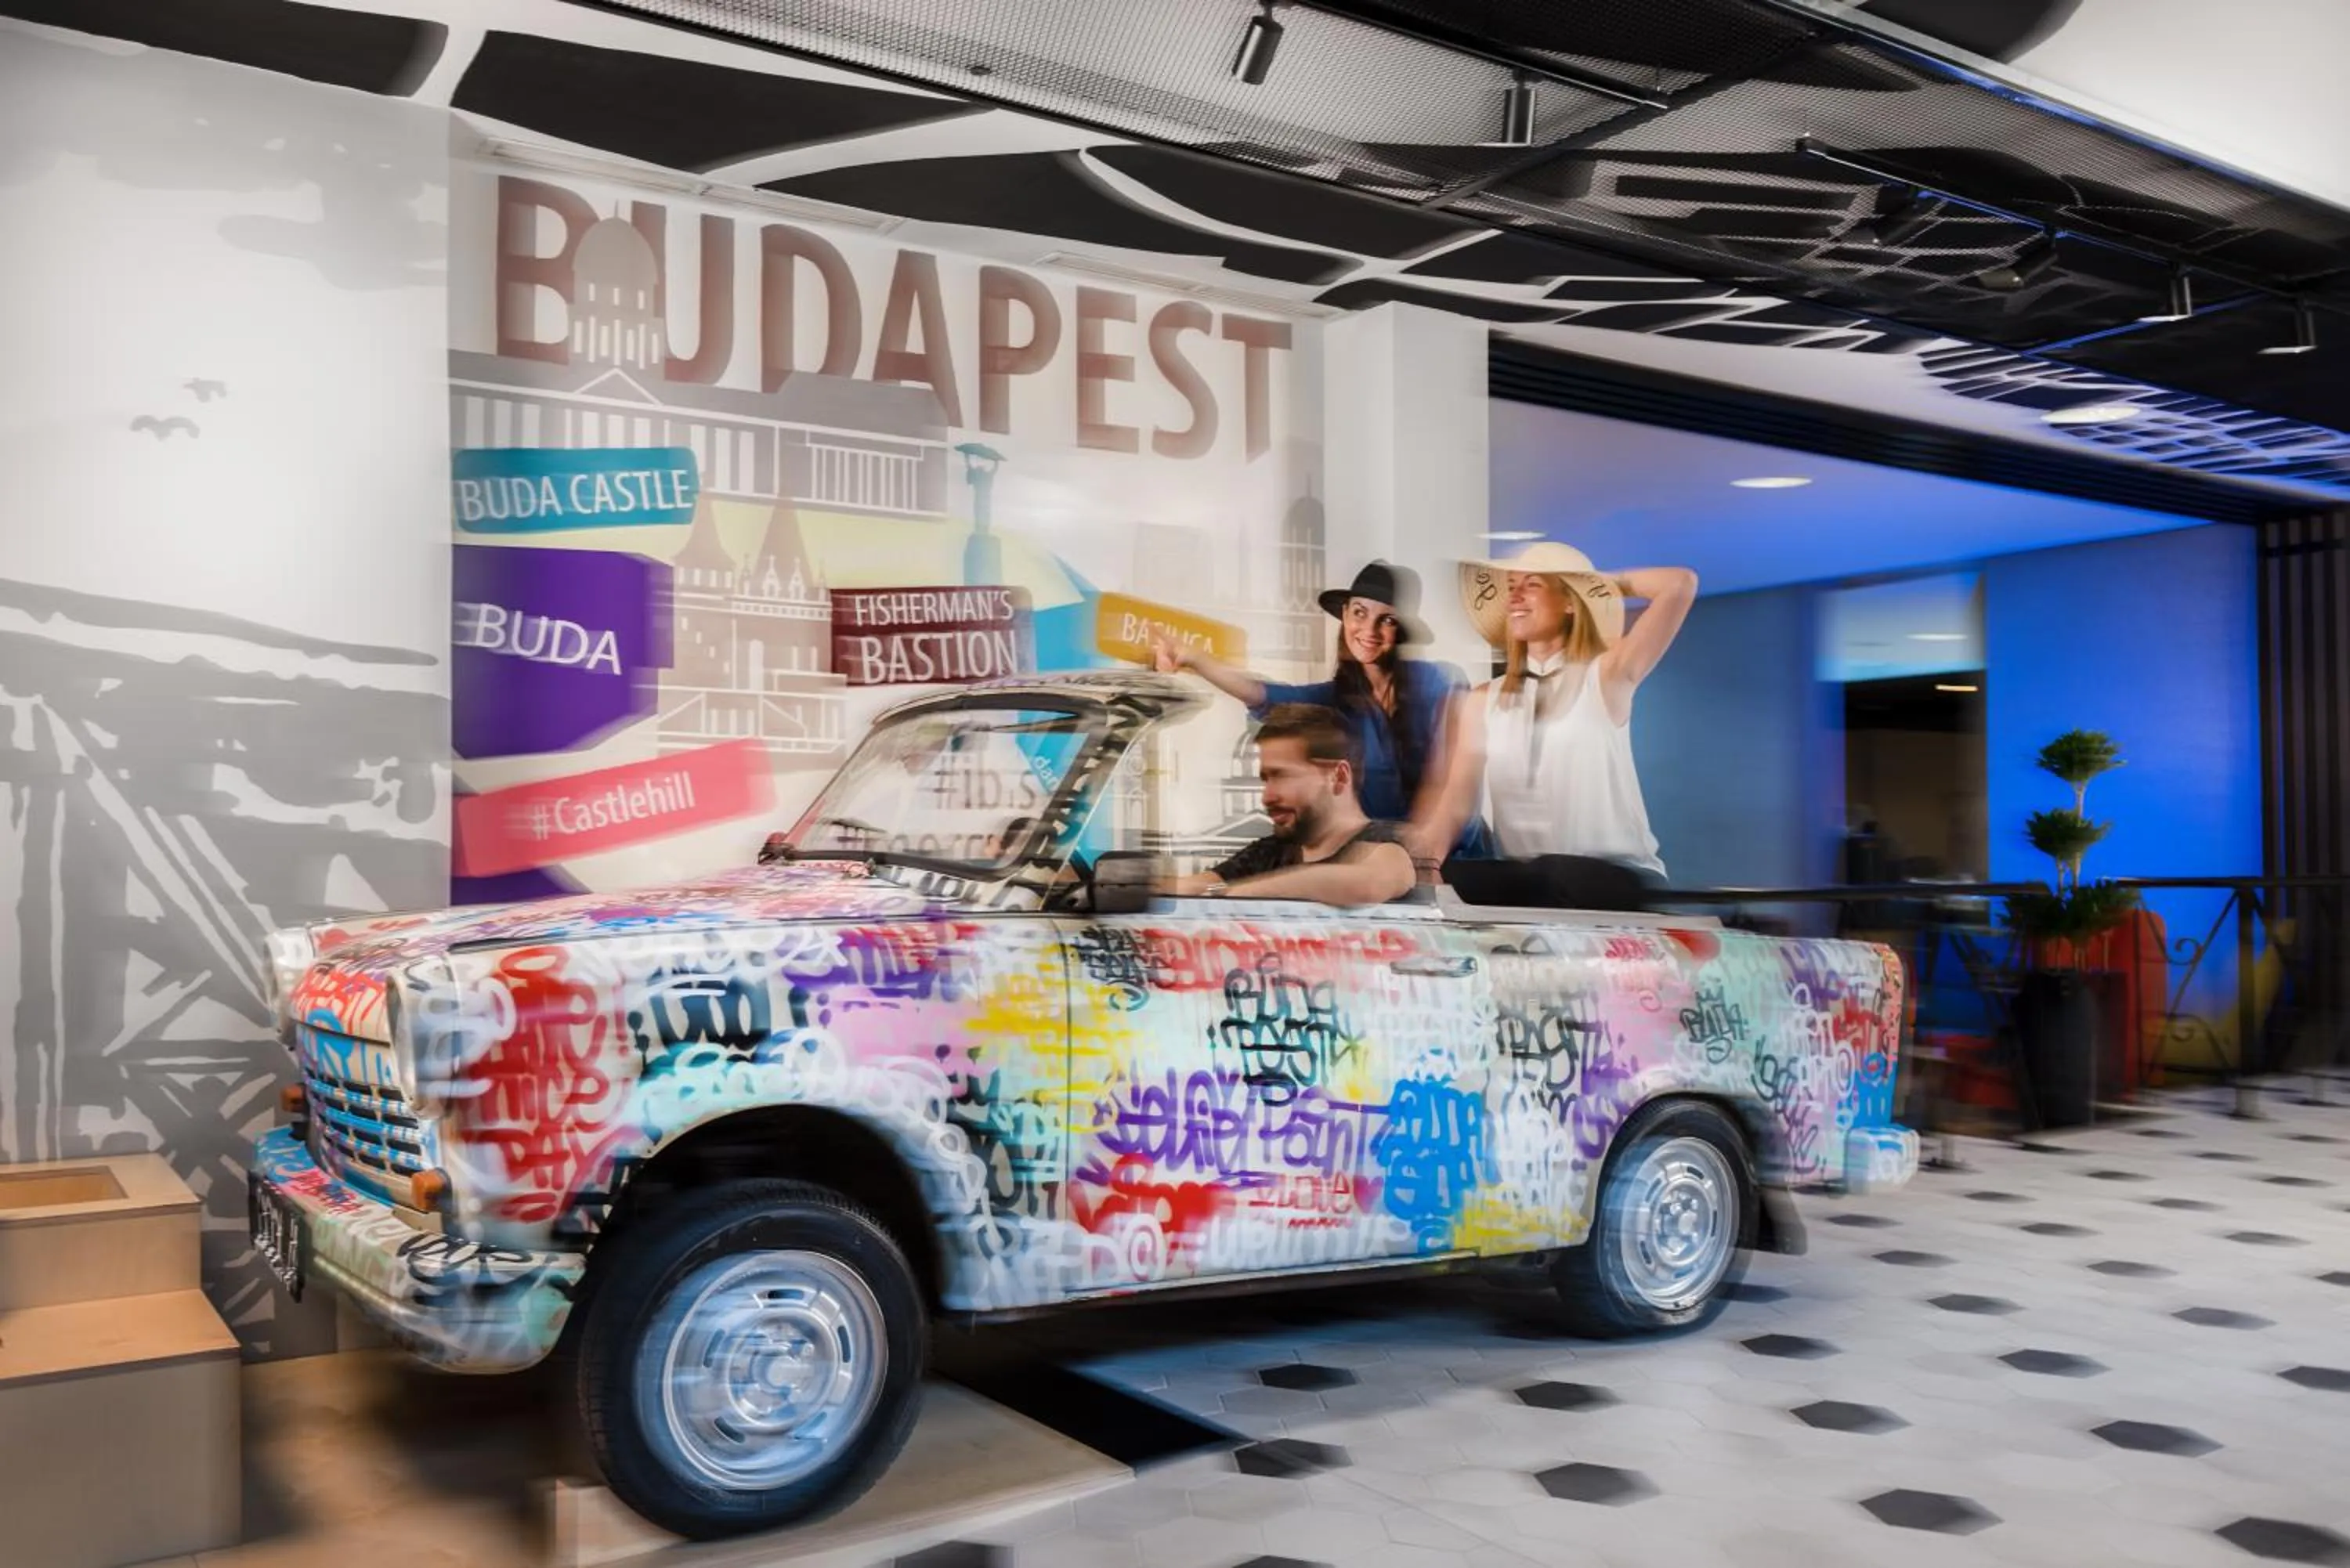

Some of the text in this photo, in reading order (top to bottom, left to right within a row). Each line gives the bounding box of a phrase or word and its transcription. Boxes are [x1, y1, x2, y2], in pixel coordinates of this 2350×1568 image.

[496, 175, 1292, 464] BUDAPEST
[460, 469, 694, 522] BUDA CASTLE
[475, 603, 622, 675] BUDA
[855, 590, 1014, 627] FISHERMAN'S
[860, 630, 1018, 685] BASTION
[530, 770, 695, 840] #Castlehill
